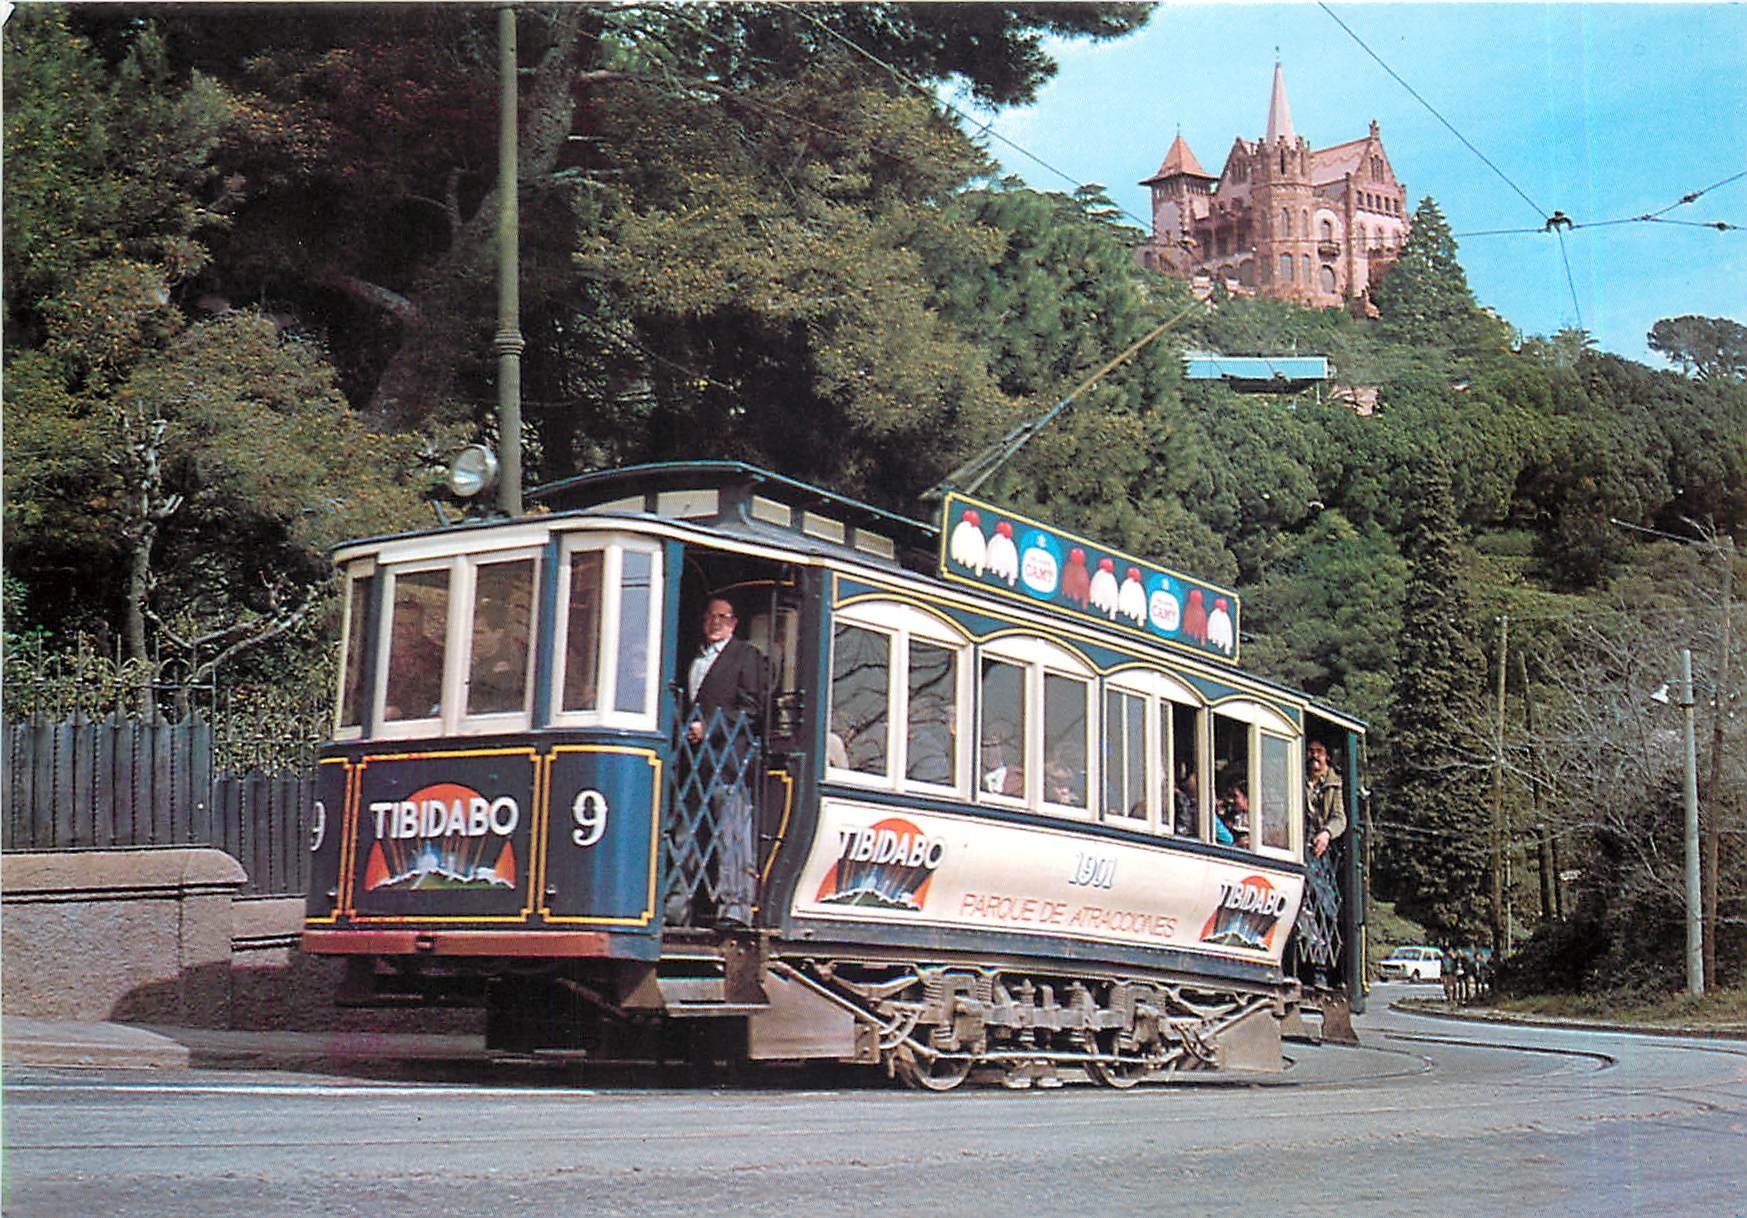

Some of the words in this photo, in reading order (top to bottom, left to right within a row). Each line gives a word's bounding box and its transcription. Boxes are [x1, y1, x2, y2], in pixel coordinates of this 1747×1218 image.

[369, 796, 520, 839] TIBIDABO
[571, 790, 609, 846] 9
[837, 825, 946, 869] TIBIDABO
[1068, 850, 1118, 889] 1901
[961, 893, 1038, 921] PARQUE
[1039, 902, 1068, 924] DE
[1069, 906, 1178, 938] ATRACCIONES
[1219, 880, 1288, 917] TIBIDABO
